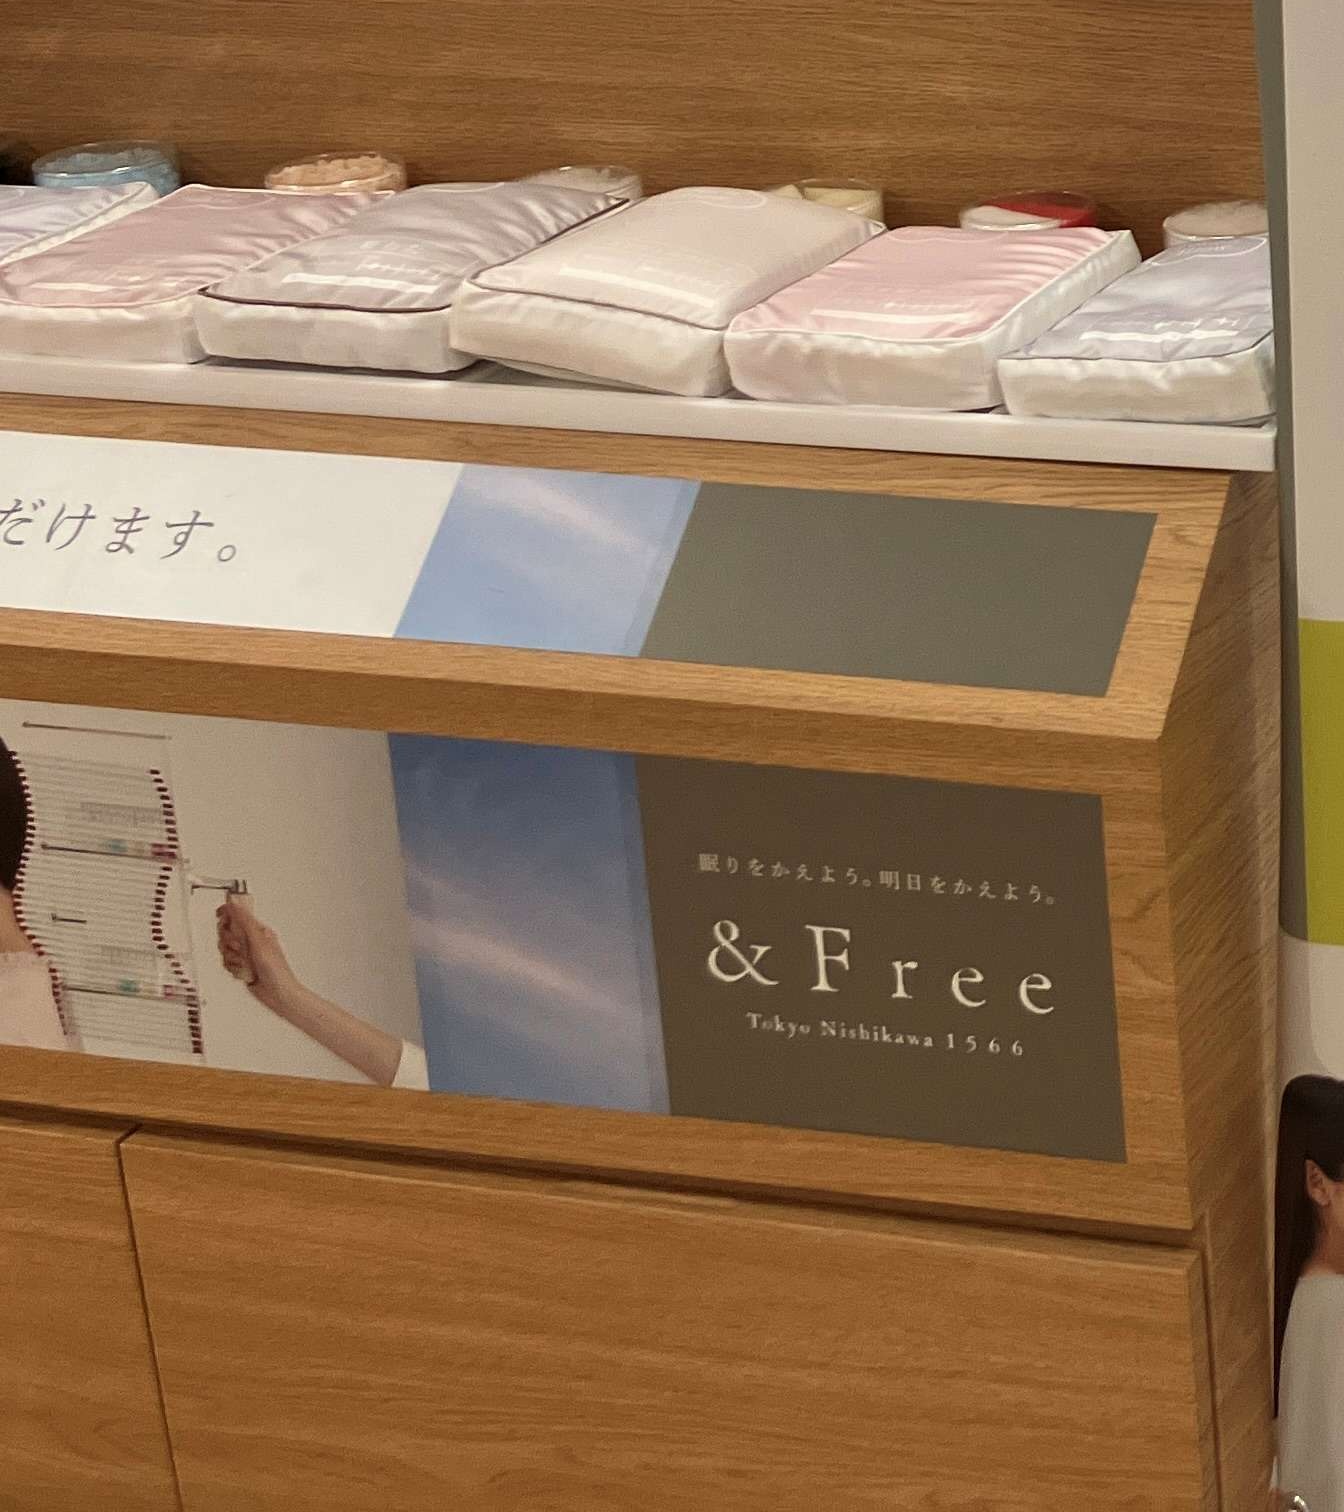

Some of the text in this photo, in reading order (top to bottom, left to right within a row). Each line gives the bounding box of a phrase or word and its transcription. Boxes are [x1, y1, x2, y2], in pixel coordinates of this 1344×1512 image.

[0, 498, 237, 563] だけます。
[698, 853, 1055, 906] 眠りをかえよう。明日をかえよう。
[746, 1012, 1024, 1057] Tokyo Nishikawa 1566
